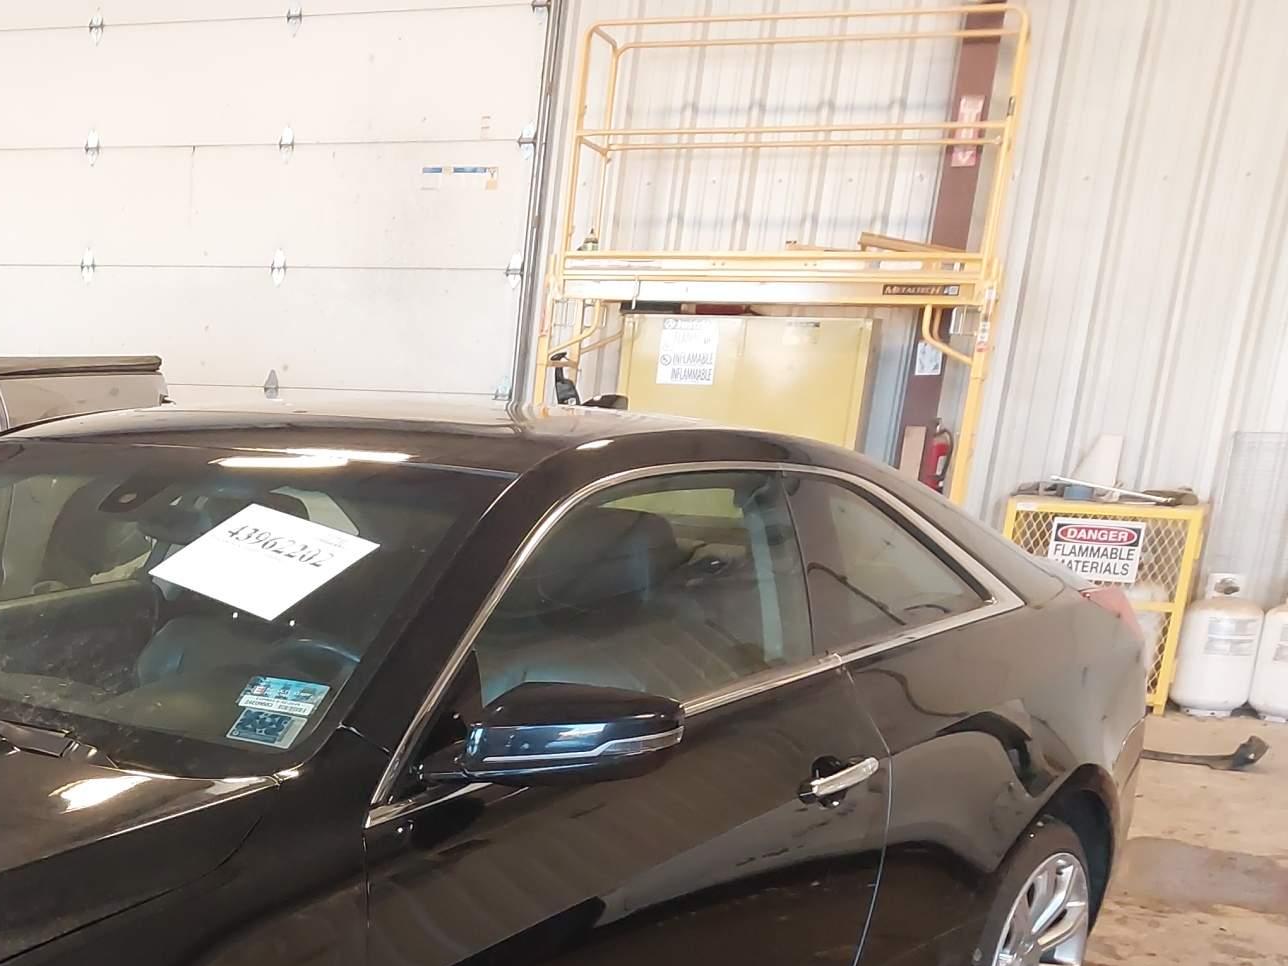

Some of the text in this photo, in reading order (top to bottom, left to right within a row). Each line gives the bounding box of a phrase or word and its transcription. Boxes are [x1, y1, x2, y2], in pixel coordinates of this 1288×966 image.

[1067, 528, 1129, 542] DANGER
[228, 525, 334, 568] 43962202
[1053, 544, 1136, 561] FLAMMABLE
[1055, 559, 1130, 576] ATERIALS
